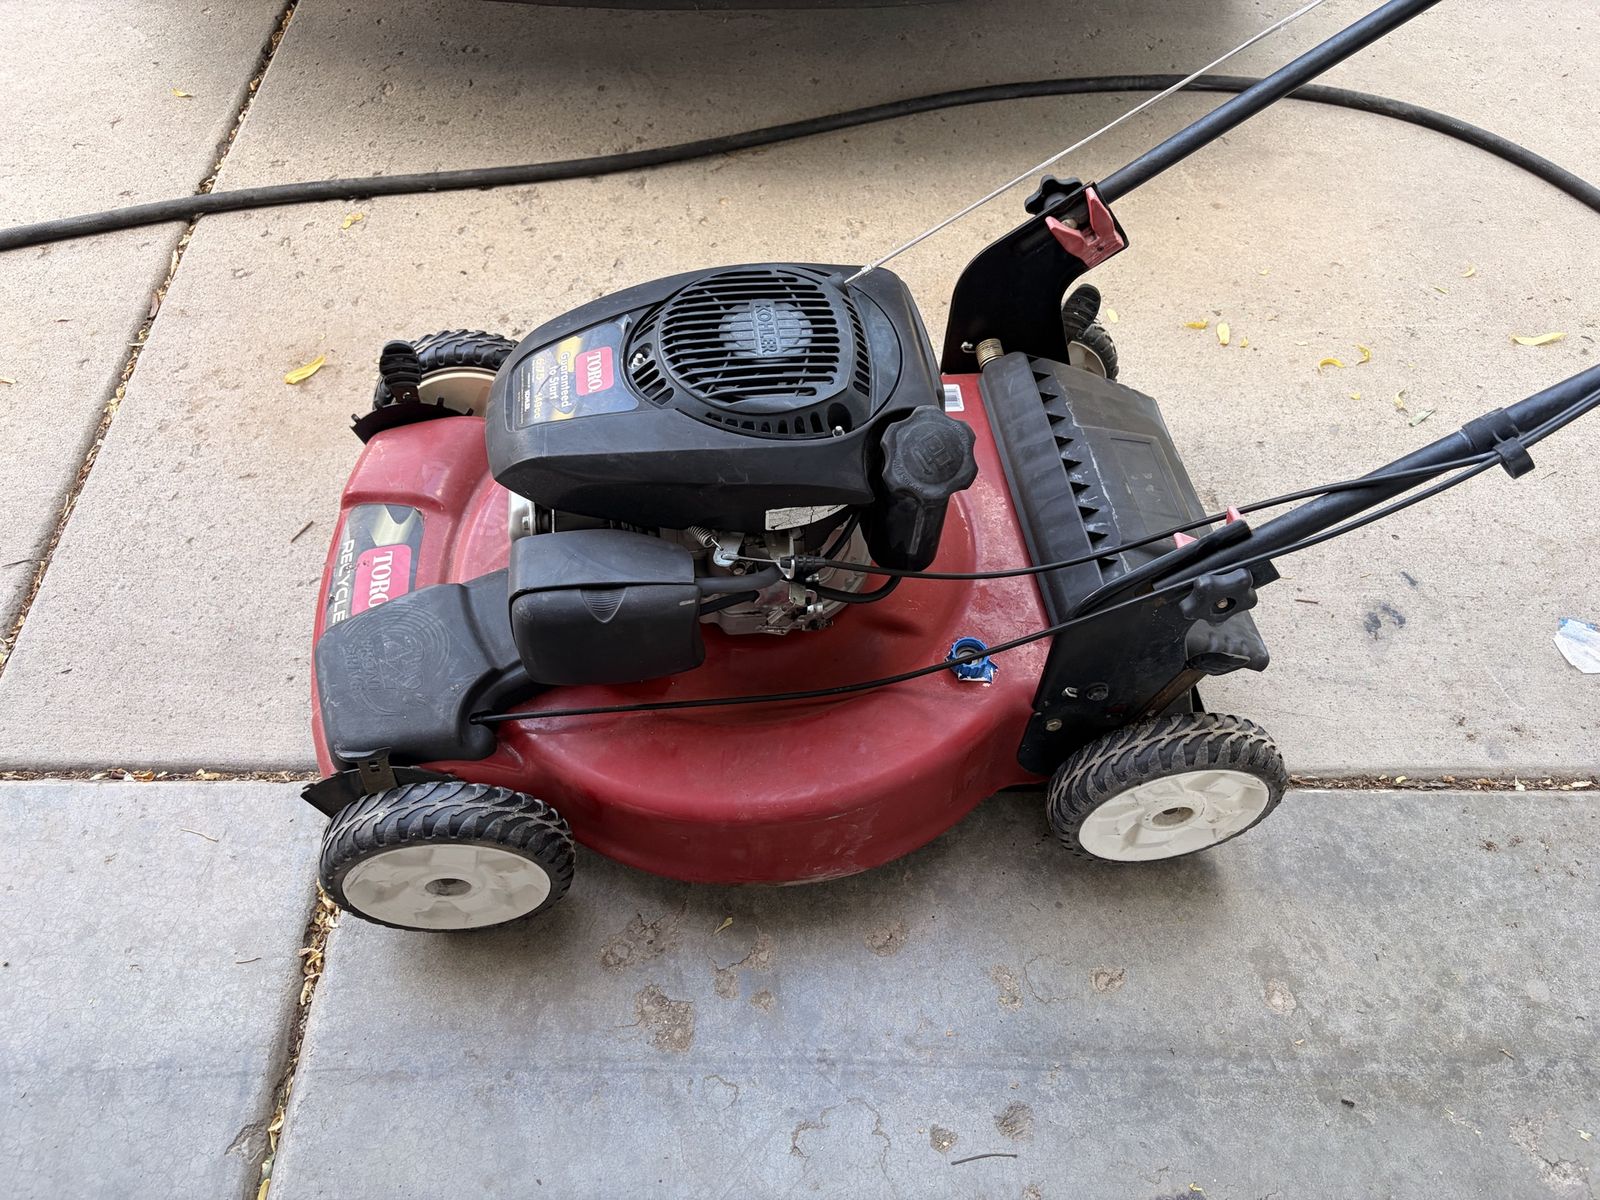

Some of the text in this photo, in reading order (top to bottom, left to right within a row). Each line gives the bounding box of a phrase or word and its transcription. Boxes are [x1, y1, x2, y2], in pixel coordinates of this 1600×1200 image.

[755, 304, 777, 354] KOHLER
[549, 365, 559, 400] to Start
[560, 352, 572, 408] Guaranteed
